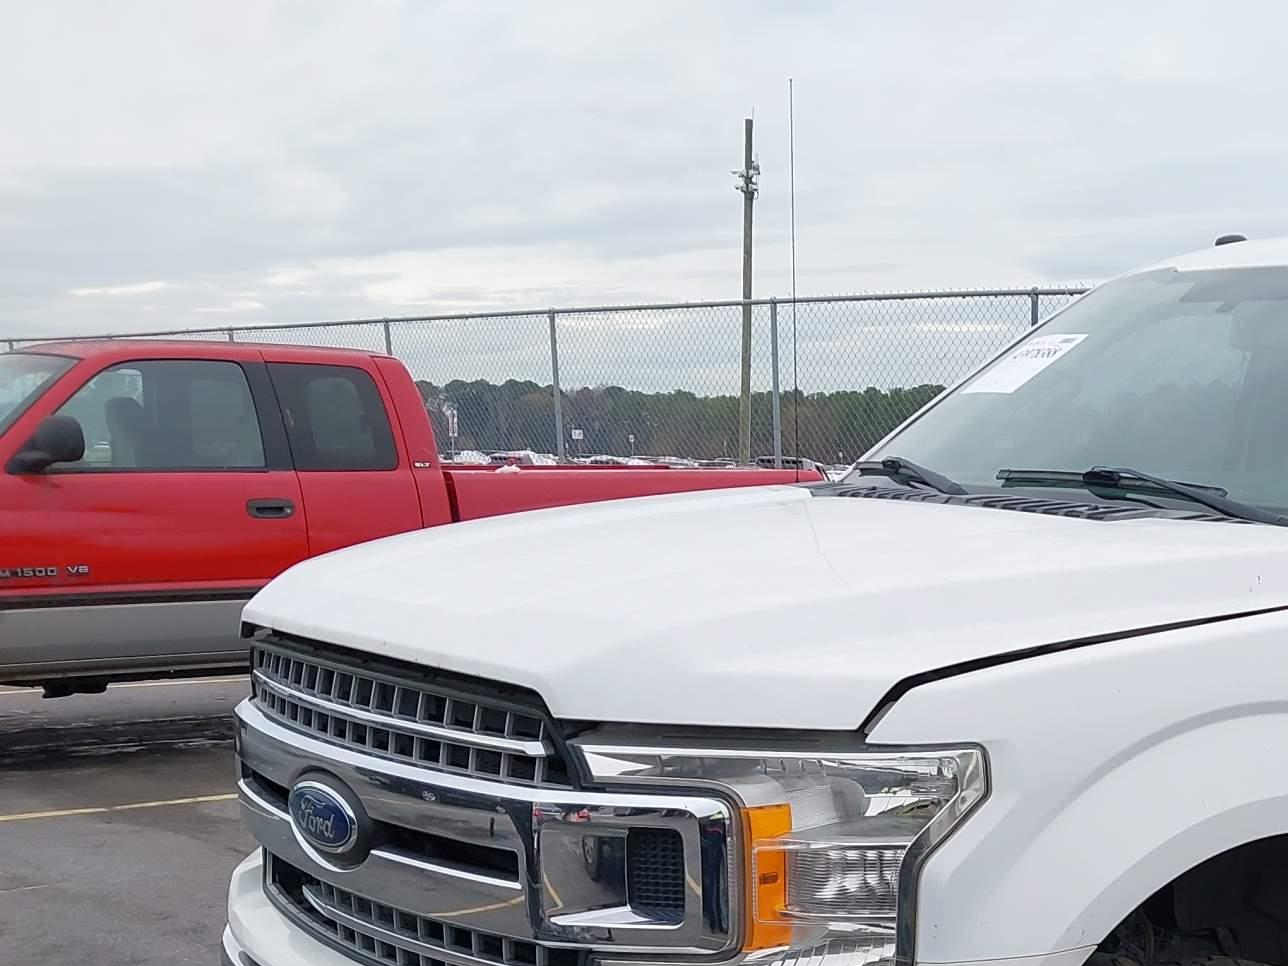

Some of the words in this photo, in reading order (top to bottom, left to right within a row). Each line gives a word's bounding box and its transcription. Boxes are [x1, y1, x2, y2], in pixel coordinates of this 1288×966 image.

[16, 567, 57, 577] 1500
[66, 565, 89, 573] V8
[300, 794, 336, 838] Ford
